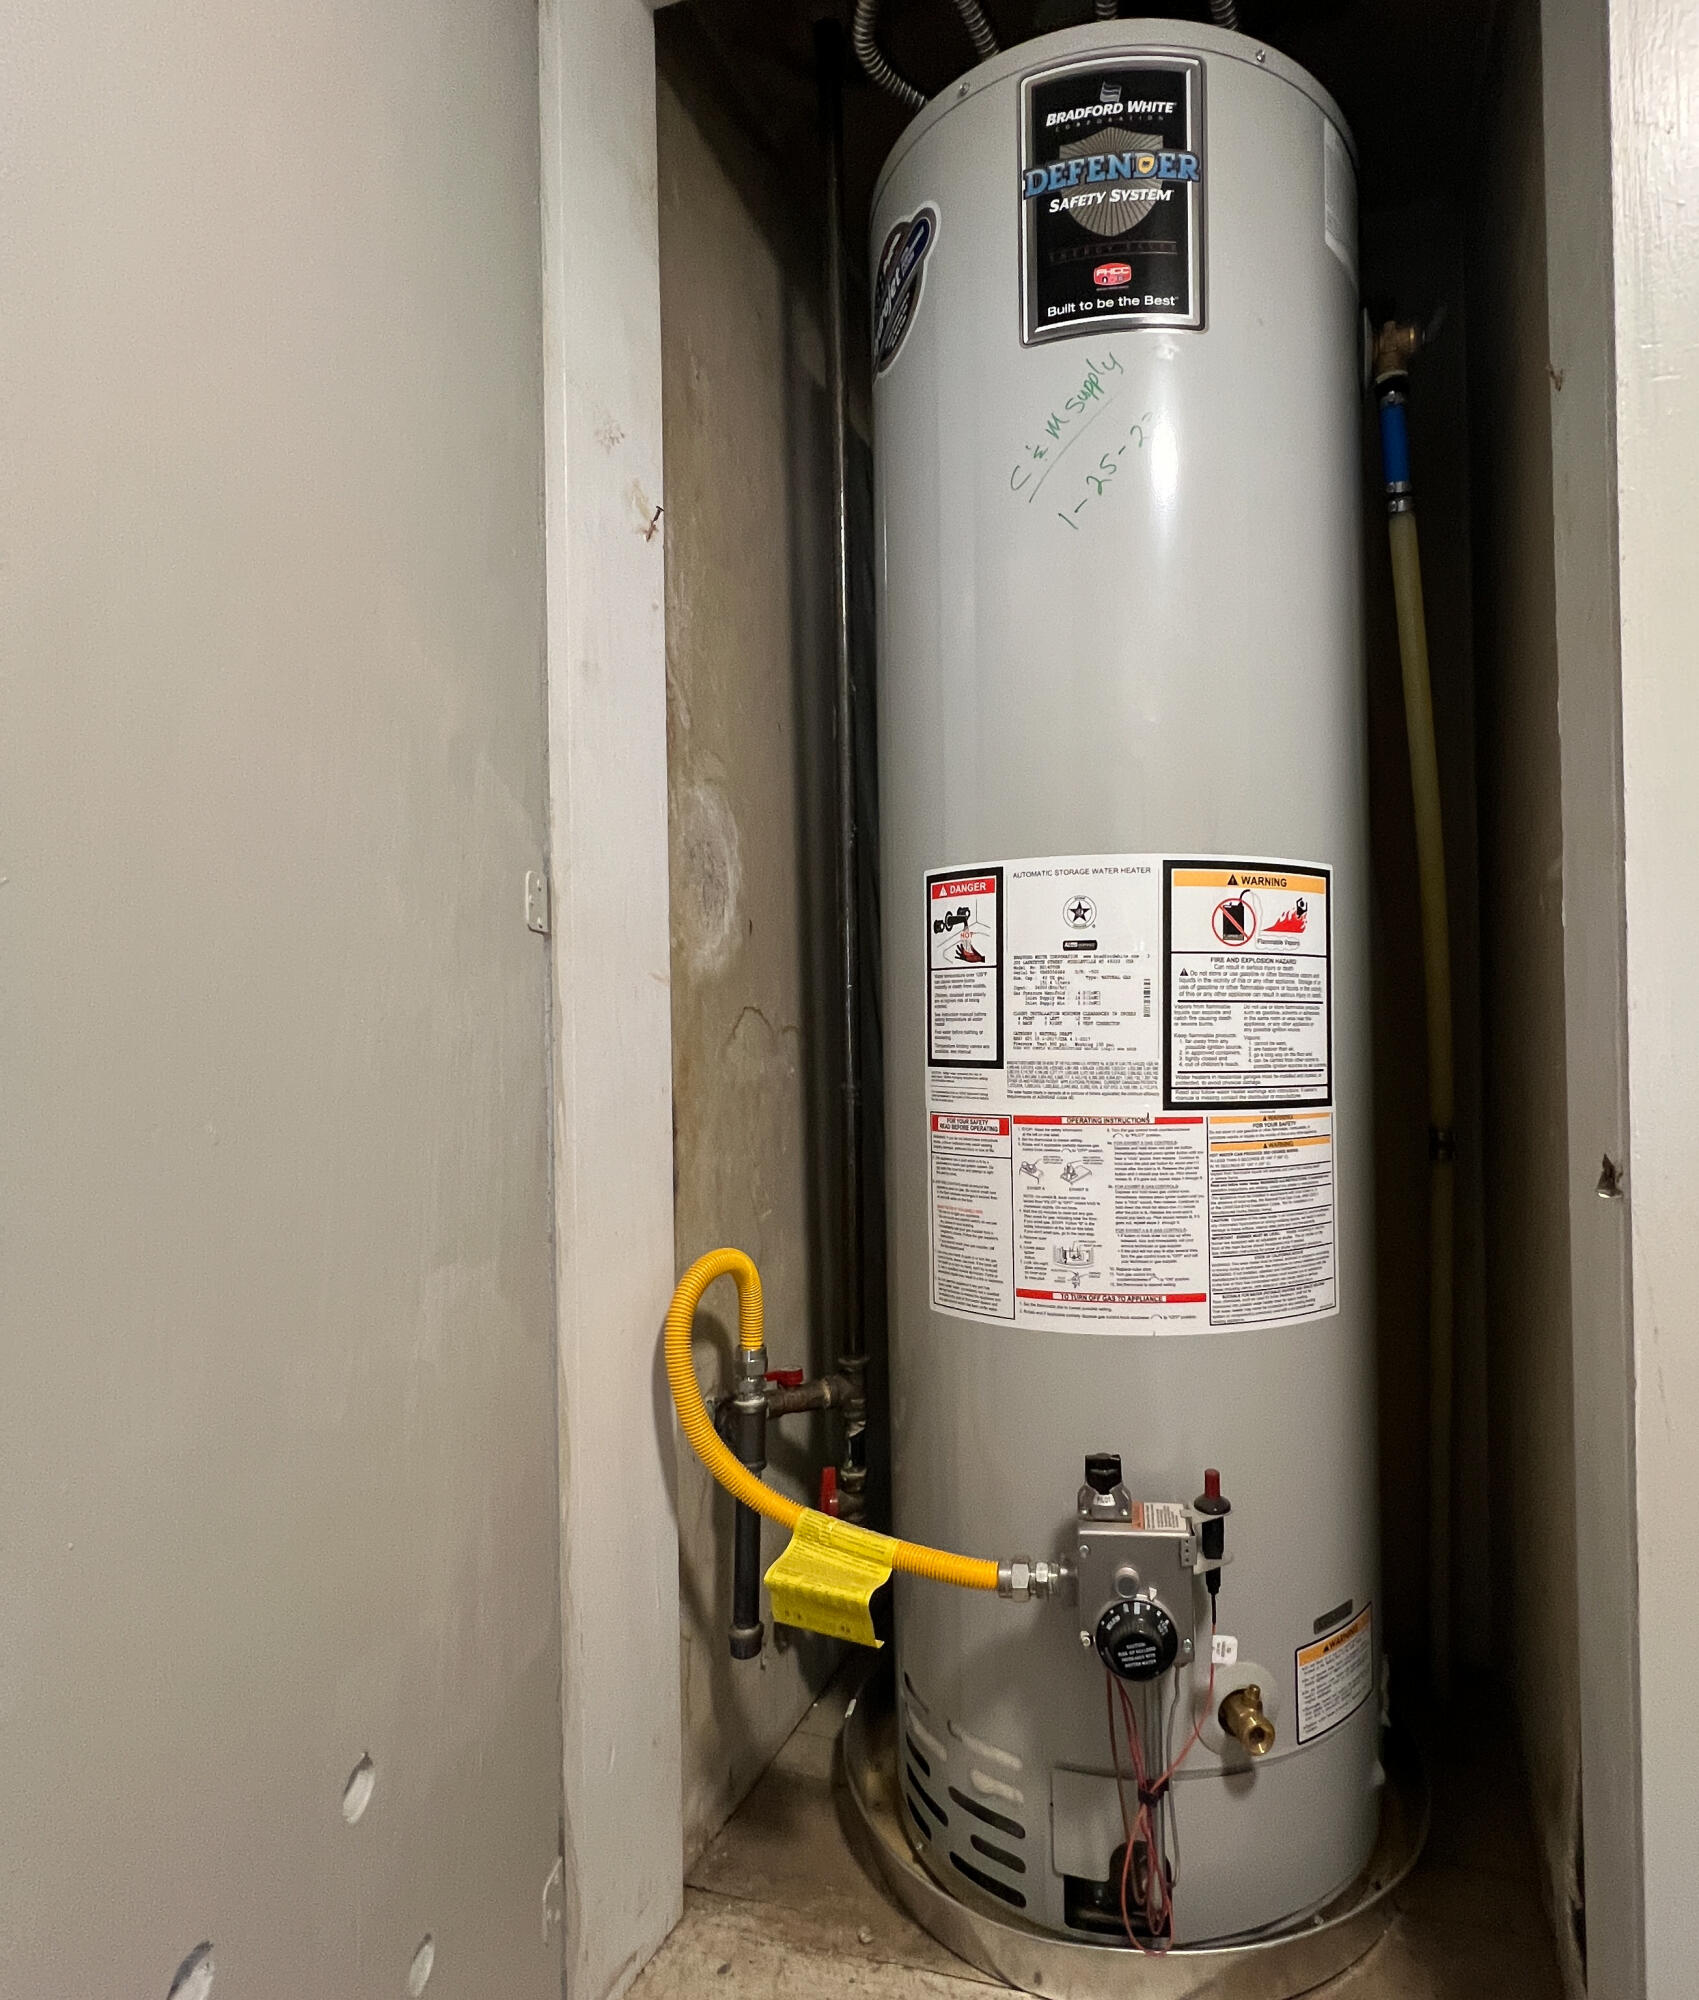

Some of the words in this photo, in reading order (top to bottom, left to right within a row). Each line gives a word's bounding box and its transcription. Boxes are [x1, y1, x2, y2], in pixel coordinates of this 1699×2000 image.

[1046, 102, 1123, 126] BRADFORD
[1127, 100, 1174, 114] WHITE
[1024, 151, 1199, 199] DEFENDER
[1049, 191, 1106, 212] SAFETY
[1109, 188, 1172, 202] SYSTEM
[1096, 266, 1130, 277] PHCC
[1048, 304, 1076, 318] Built
[1079, 302, 1092, 310] to
[1097, 299, 1114, 308] be
[1118, 296, 1140, 307] the
[1144, 295, 1176, 306] Best
[1013, 870, 1052, 878] AUTOMATIC
[1054, 868, 1090, 876] STORAGE
[1241, 876, 1288, 887] WARNING
[950, 882, 986, 894] DANGER
[1328, 1623, 1359, 1649] WARNING
